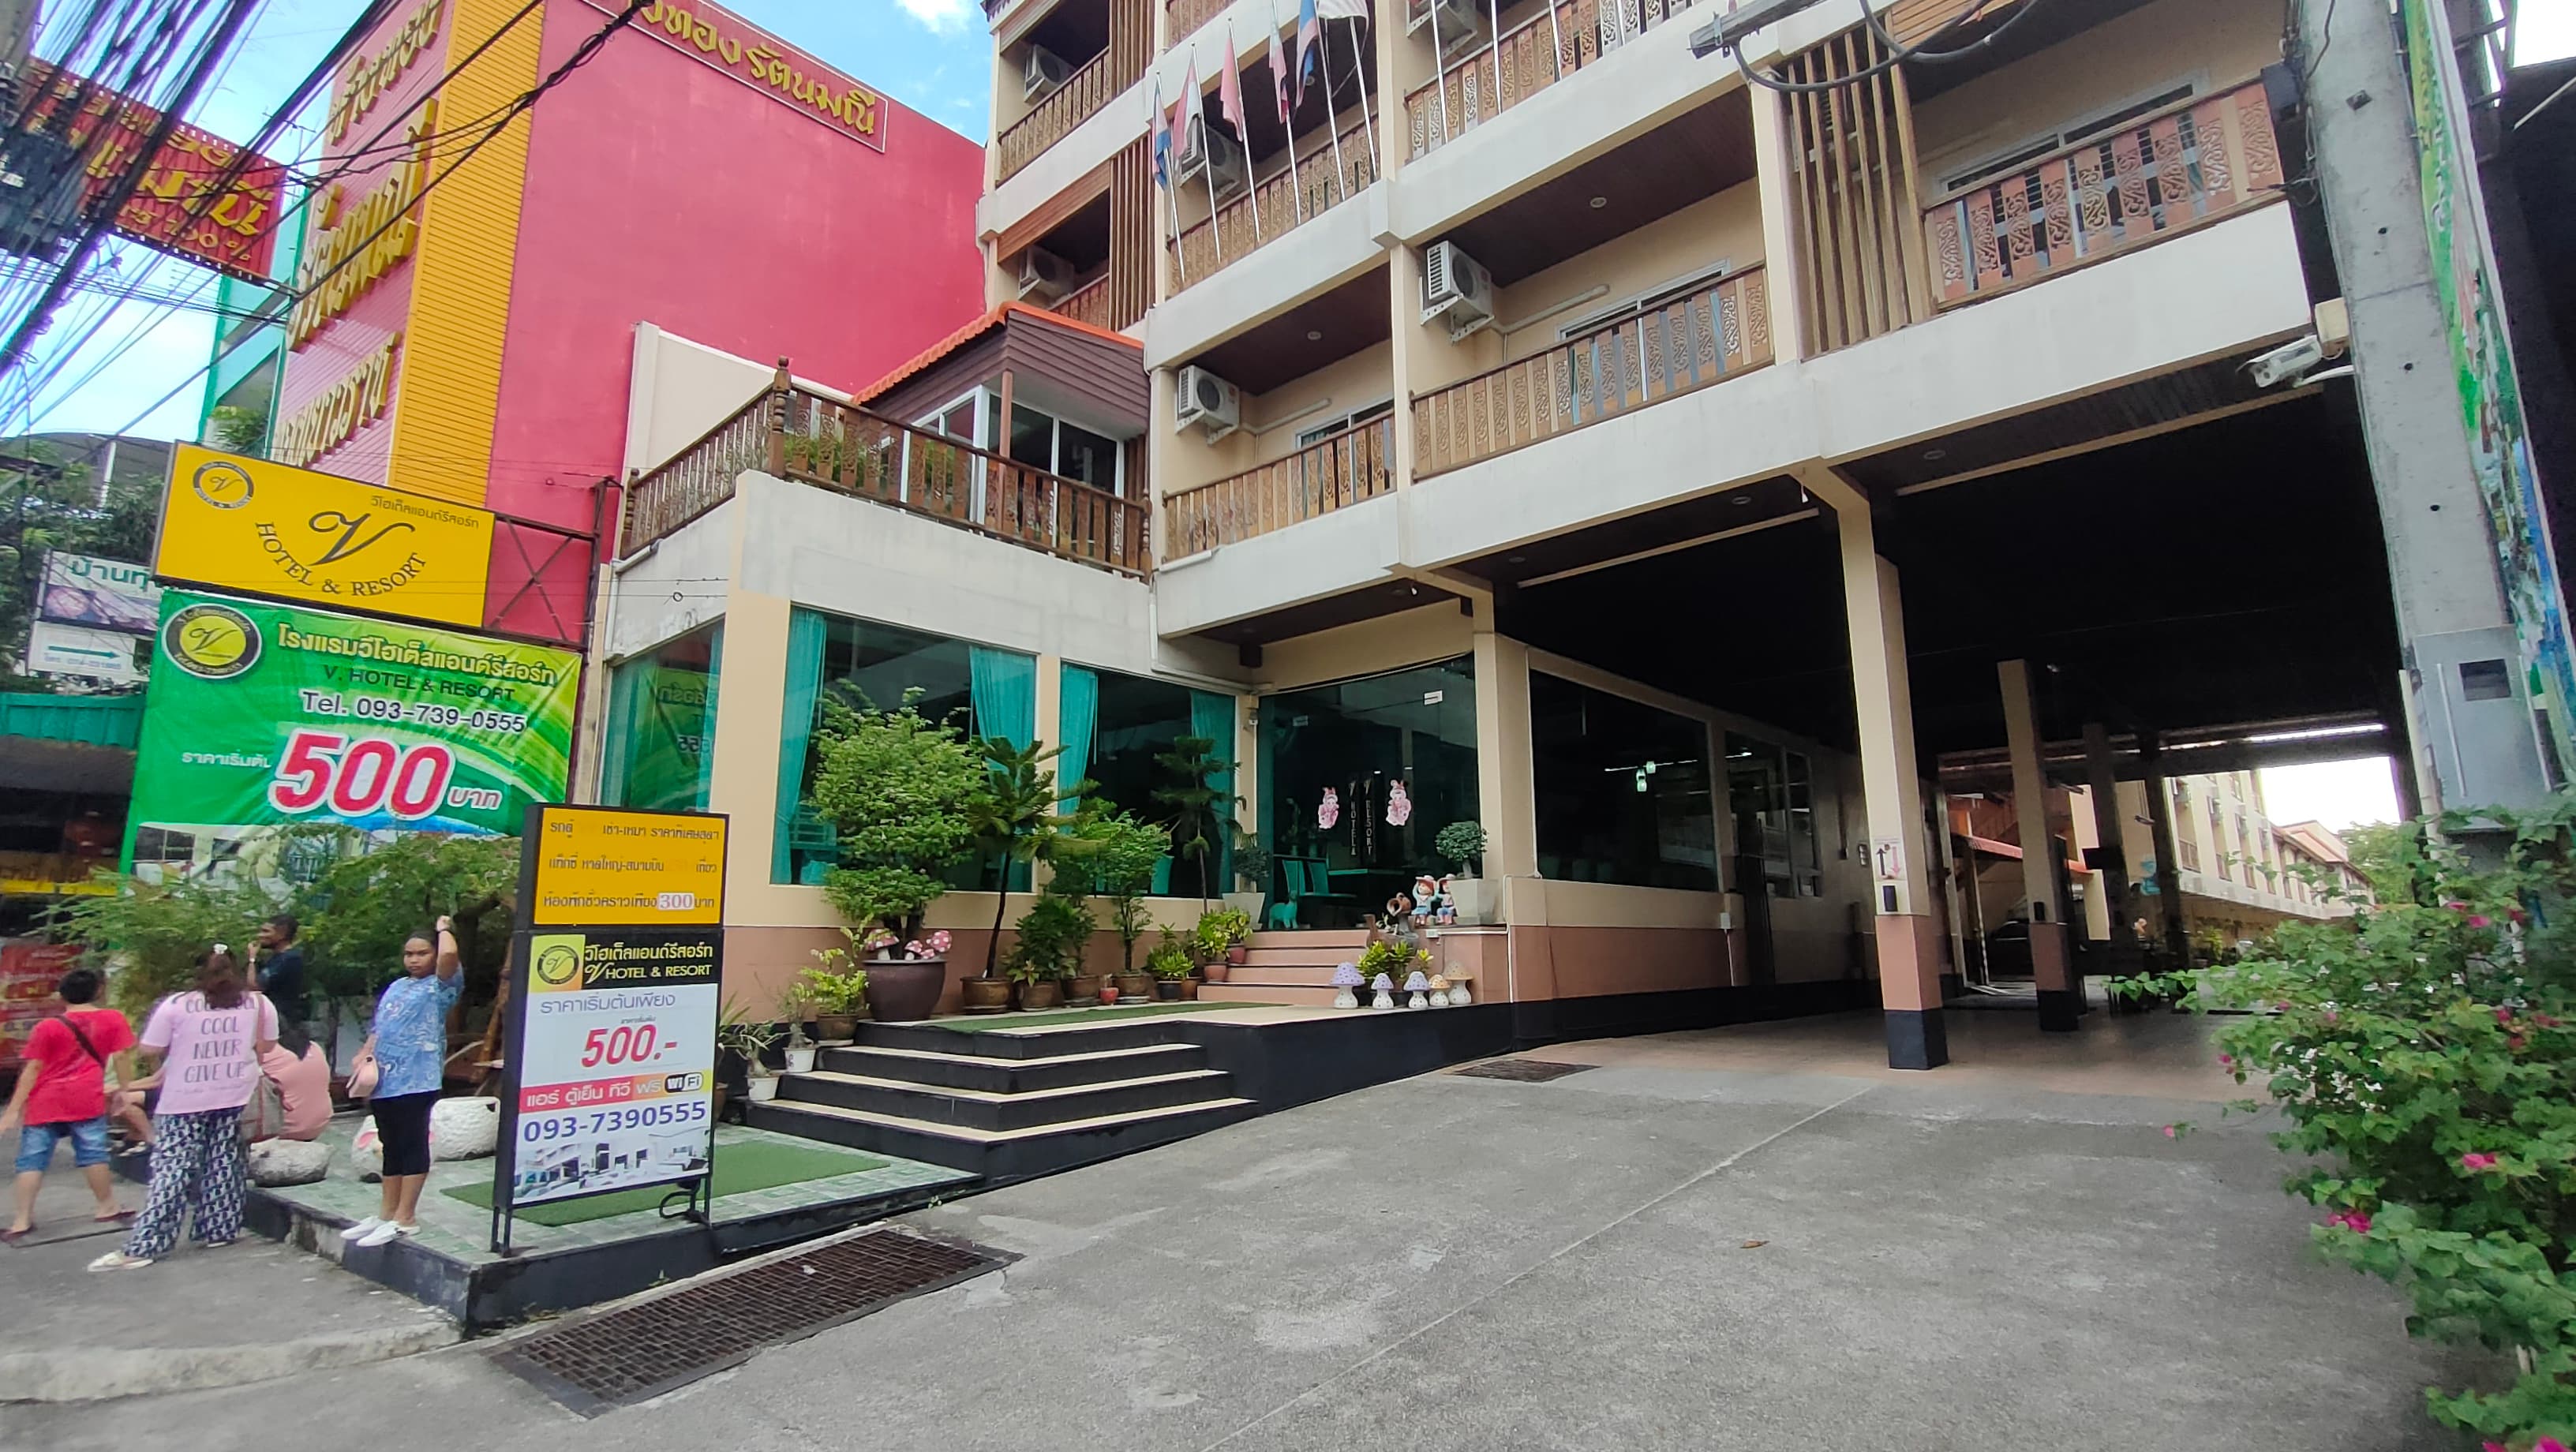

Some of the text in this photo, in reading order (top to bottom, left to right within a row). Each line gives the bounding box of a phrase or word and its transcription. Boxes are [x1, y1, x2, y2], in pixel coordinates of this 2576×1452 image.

[255, 521, 427, 597] HOTEL & RESORT
[350, 668, 416, 691] HOTEL
[422, 679, 436, 692] &
[440, 681, 515, 702] RESORT
[302, 690, 526, 733] Tel. 093-739-0555
[271, 730, 453, 819] 500
[660, 894, 693, 908] 300
[651, 967, 661, 978] &
[665, 964, 713, 977] RESORT
[540, 991, 676, 1014] ราคาเริ่มต้นเพียง
[200, 1016, 240, 1035] COOL
[193, 1038, 243, 1060] NEVER
[184, 1063, 222, 1083] GIVE
[526, 1091, 560, 1106] แอร์
[565, 1084, 604, 1105] ตู้เย็น
[524, 1101, 706, 1142] 093-7390555
